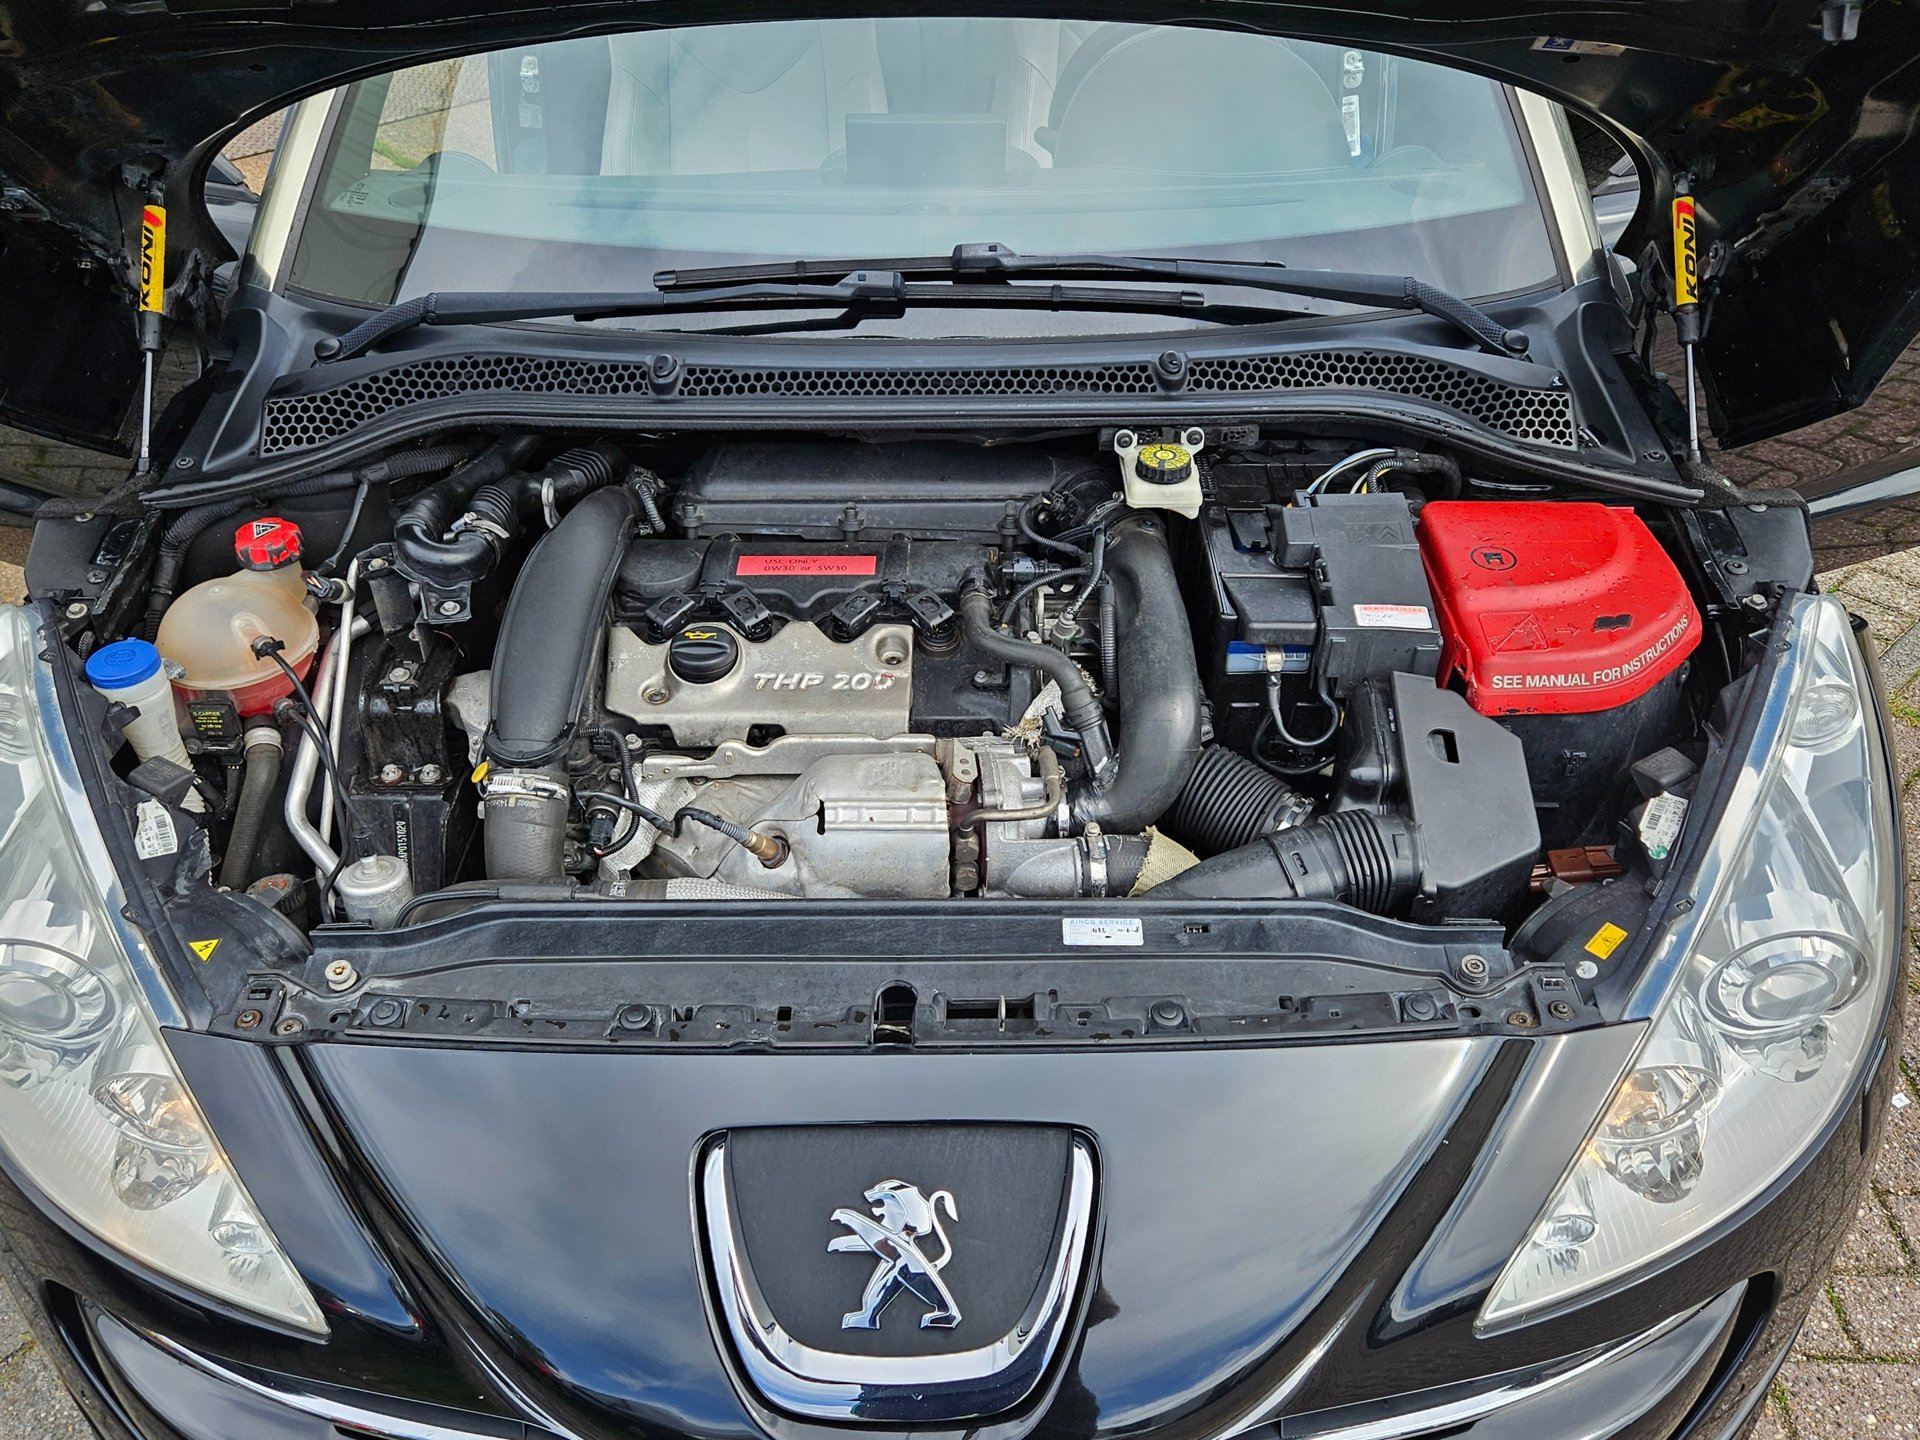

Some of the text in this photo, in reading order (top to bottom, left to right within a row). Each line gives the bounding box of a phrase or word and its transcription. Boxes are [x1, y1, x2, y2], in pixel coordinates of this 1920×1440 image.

[141, 225, 154, 307] KONI
[1682, 218, 1697, 300] KONI
[753, 672, 896, 691] THP 200
[1492, 614, 1689, 689] SEE MANUAL FOR INSTRUCTIONS
